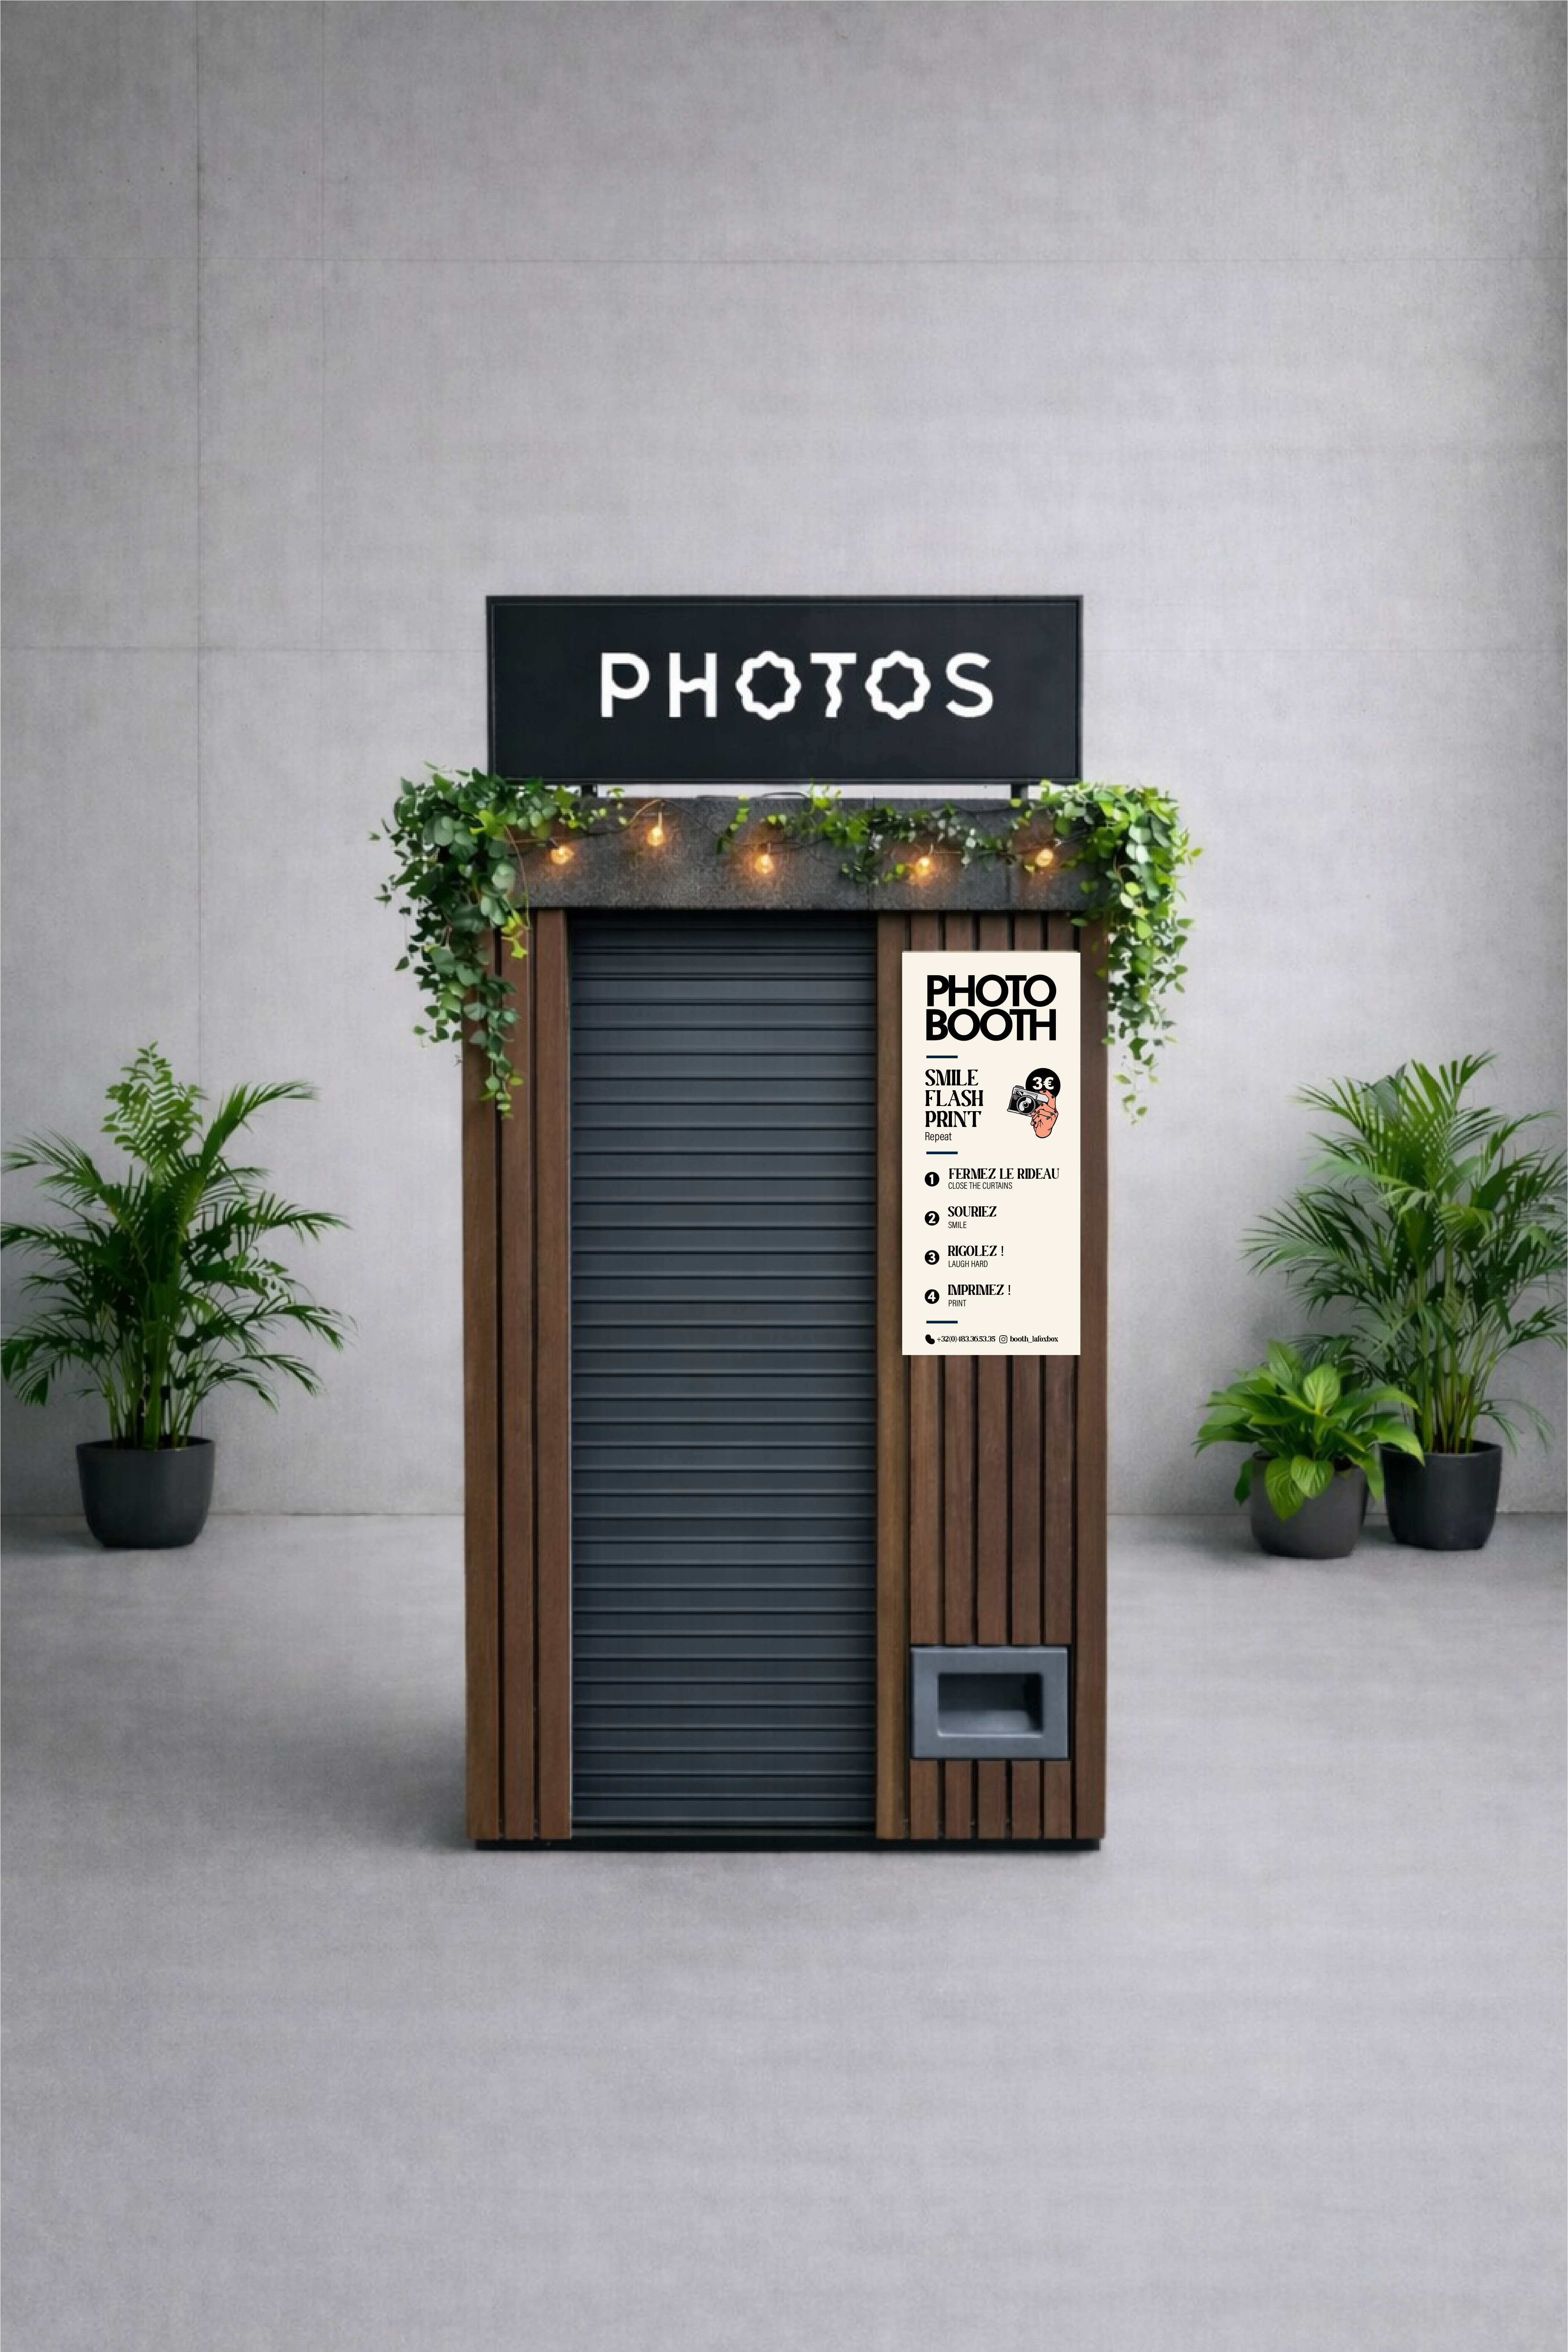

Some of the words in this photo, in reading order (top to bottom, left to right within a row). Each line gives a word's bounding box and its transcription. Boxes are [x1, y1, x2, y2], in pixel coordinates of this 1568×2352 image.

[601, 651, 993, 720] PHOTOS
[927, 974, 1057, 1007] PHOTO
[926, 1008, 1056, 1041] BOOTH
[925, 1069, 979, 1086] SMILE
[1032, 1077, 1054, 1090] 3€
[925, 1089, 983, 1107] FLASH
[925, 1110, 982, 1127] PRINT
[925, 1132, 952, 1143] Repeat
[929, 1174, 934, 1185] 1
[949, 1168, 996, 1179] FERMEZ
[1000, 1168, 1014, 1179] LE
[1017, 1168, 1060, 1179] RIDEAU
[928, 1213, 936, 1224] 2
[948, 1206, 997, 1217] SOURIEZ
[928, 1252, 936, 1263] 3
[948, 1245, 997, 1256] RIGOLEZ
[928, 1291, 936, 1302] 4
[948, 1284, 1004, 1295] IMPRIMEZ
